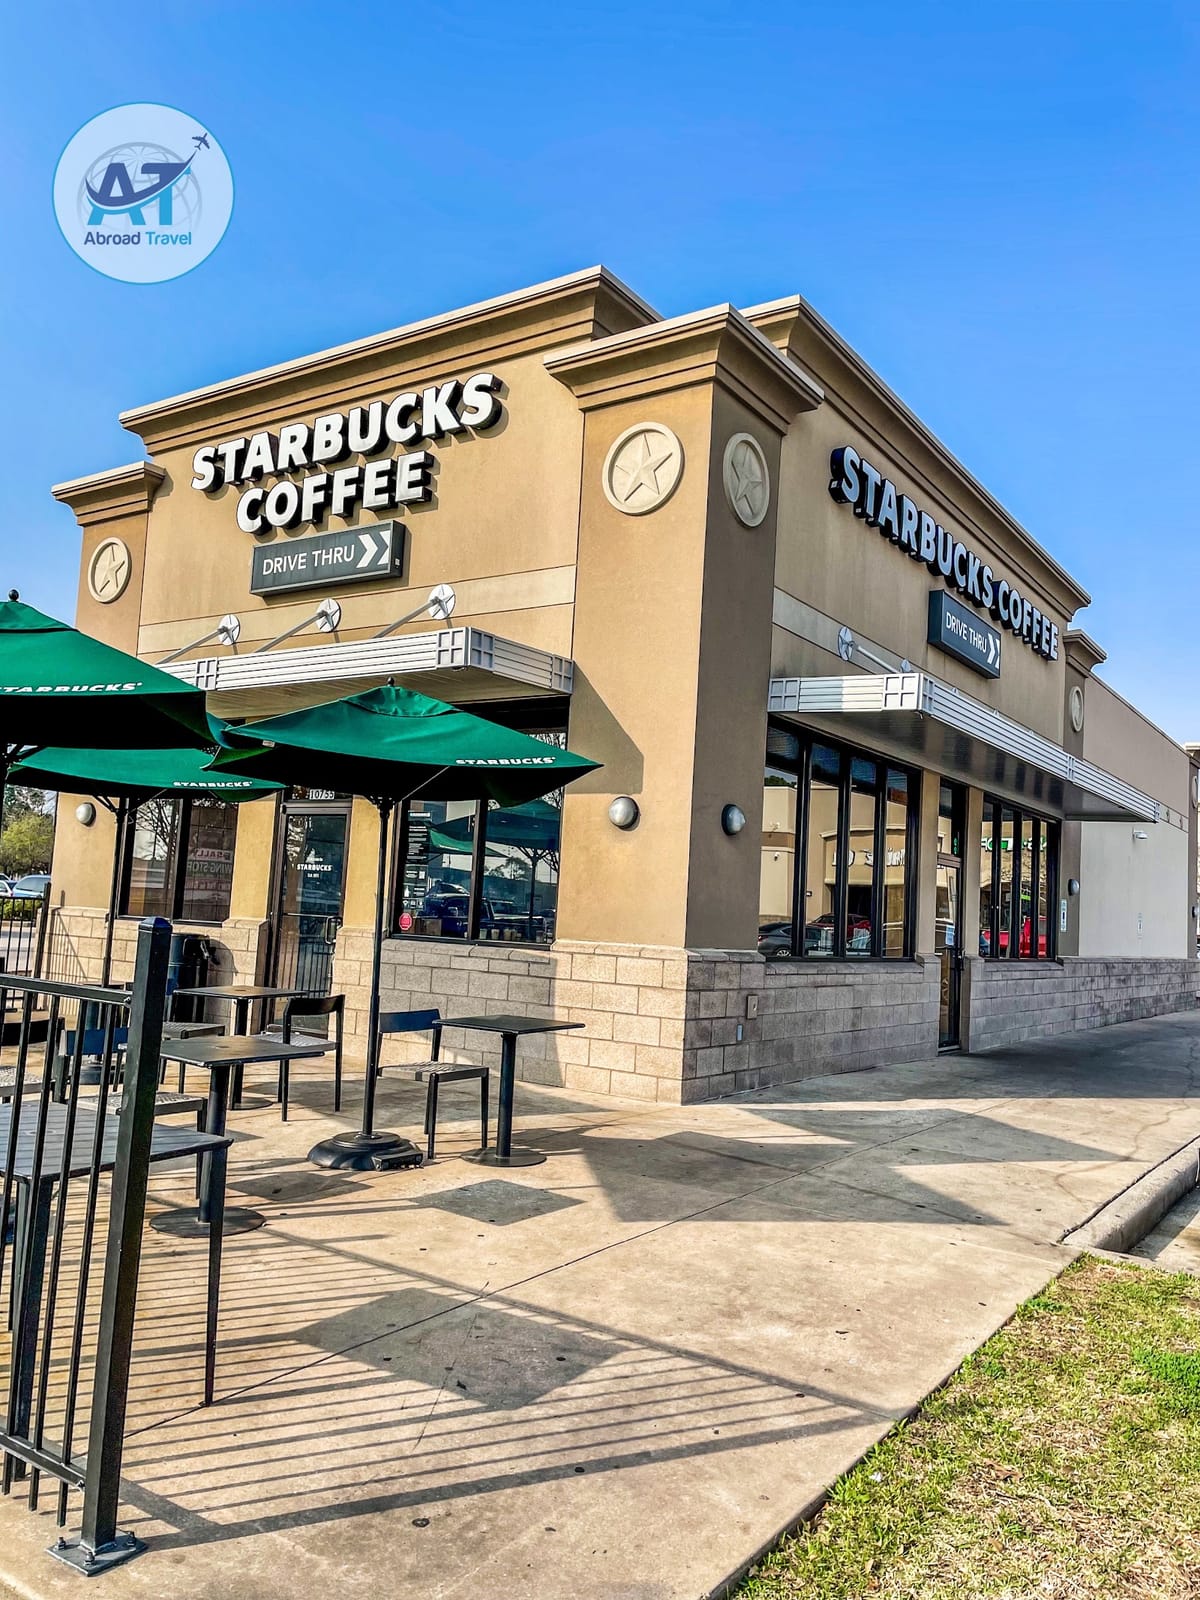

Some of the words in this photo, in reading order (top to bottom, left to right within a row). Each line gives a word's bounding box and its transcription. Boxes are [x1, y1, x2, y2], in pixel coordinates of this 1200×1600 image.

[191, 373, 497, 492] STARBUCKS
[236, 451, 428, 534] COFFEE
[262, 552, 307, 575] DRIVE
[312, 544, 355, 567] THRU
[840, 446, 994, 609] STARBUCKS
[997, 579, 1060, 662] COFFEE
[946, 611, 968, 640] DRIVE
[969, 627, 987, 653] THRU
[0, 682, 143, 693] TARBUCKS
[455, 757, 556, 765] STARBUCKS
[297, 863, 332, 871] STARBUCKS
